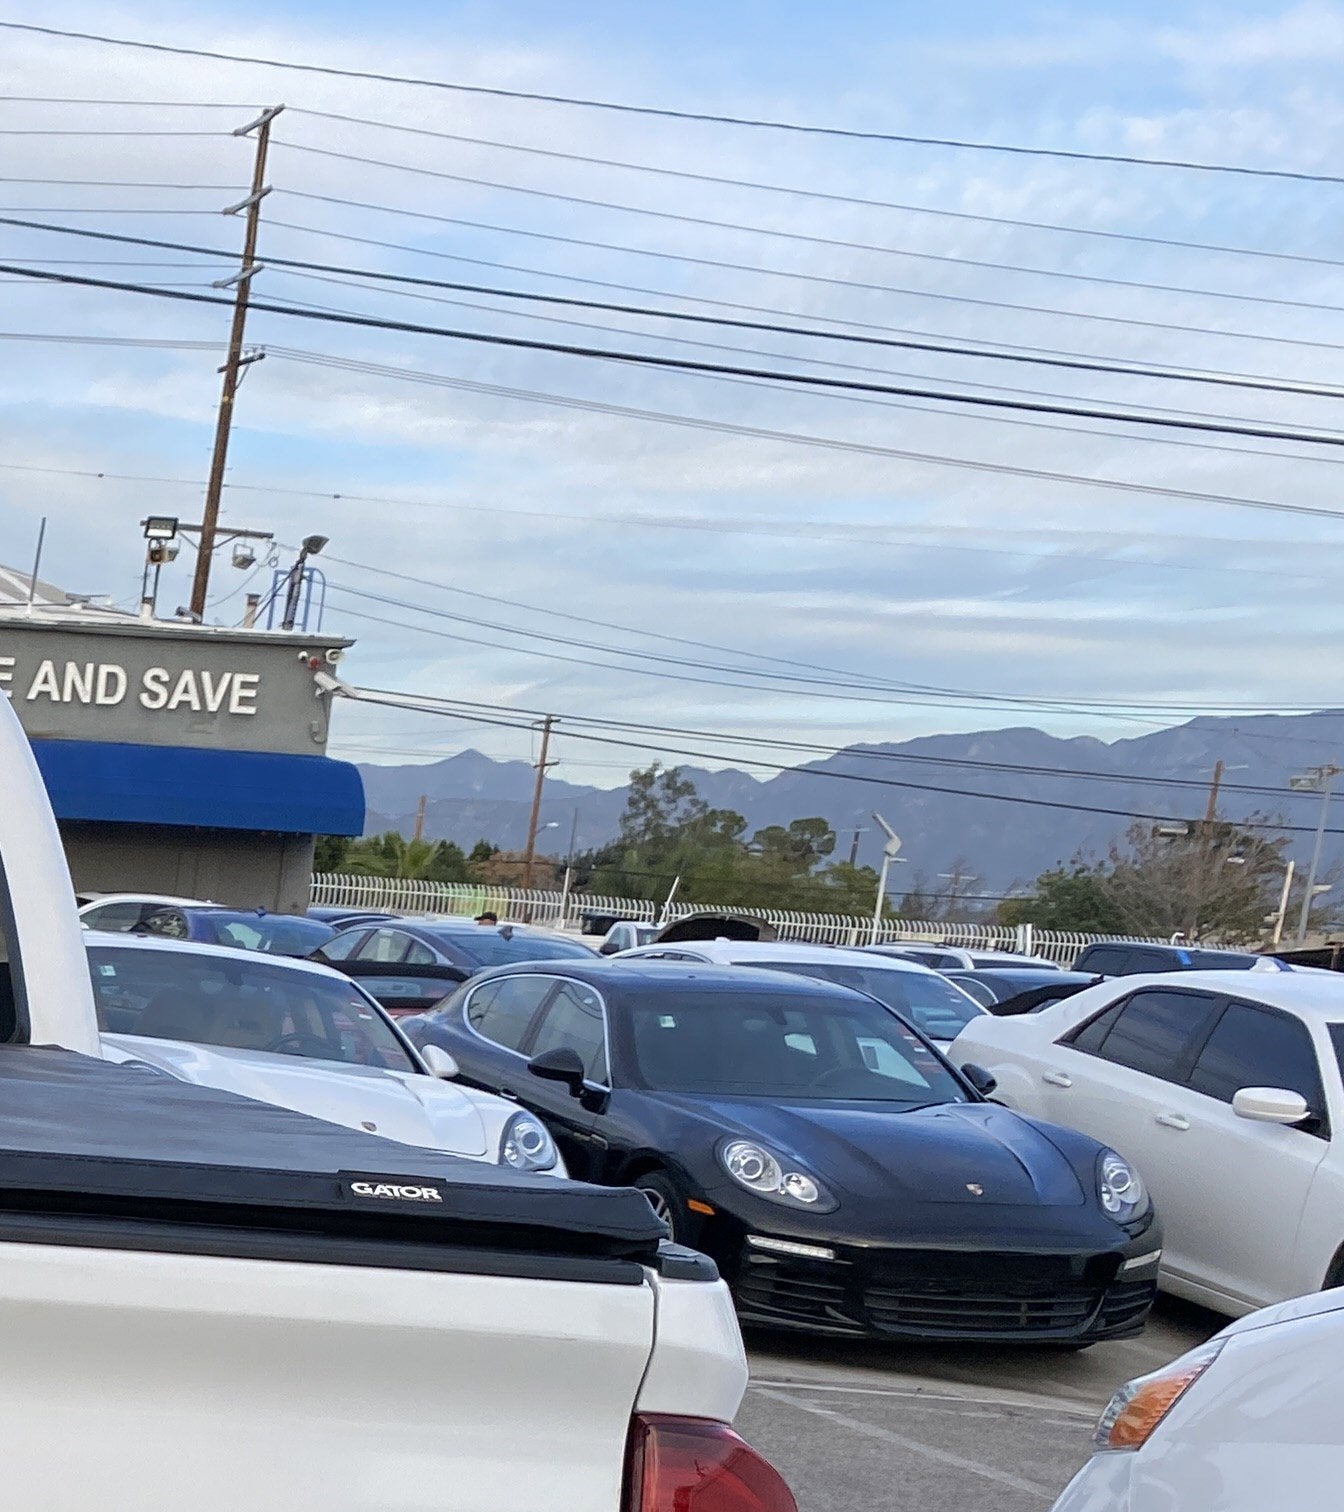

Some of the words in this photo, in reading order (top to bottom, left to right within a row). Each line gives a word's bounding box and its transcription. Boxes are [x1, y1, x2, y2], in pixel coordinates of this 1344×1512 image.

[26, 659, 128, 705] AND
[139, 667, 260, 715] SAVE
[350, 1181, 443, 1201] GATOR
